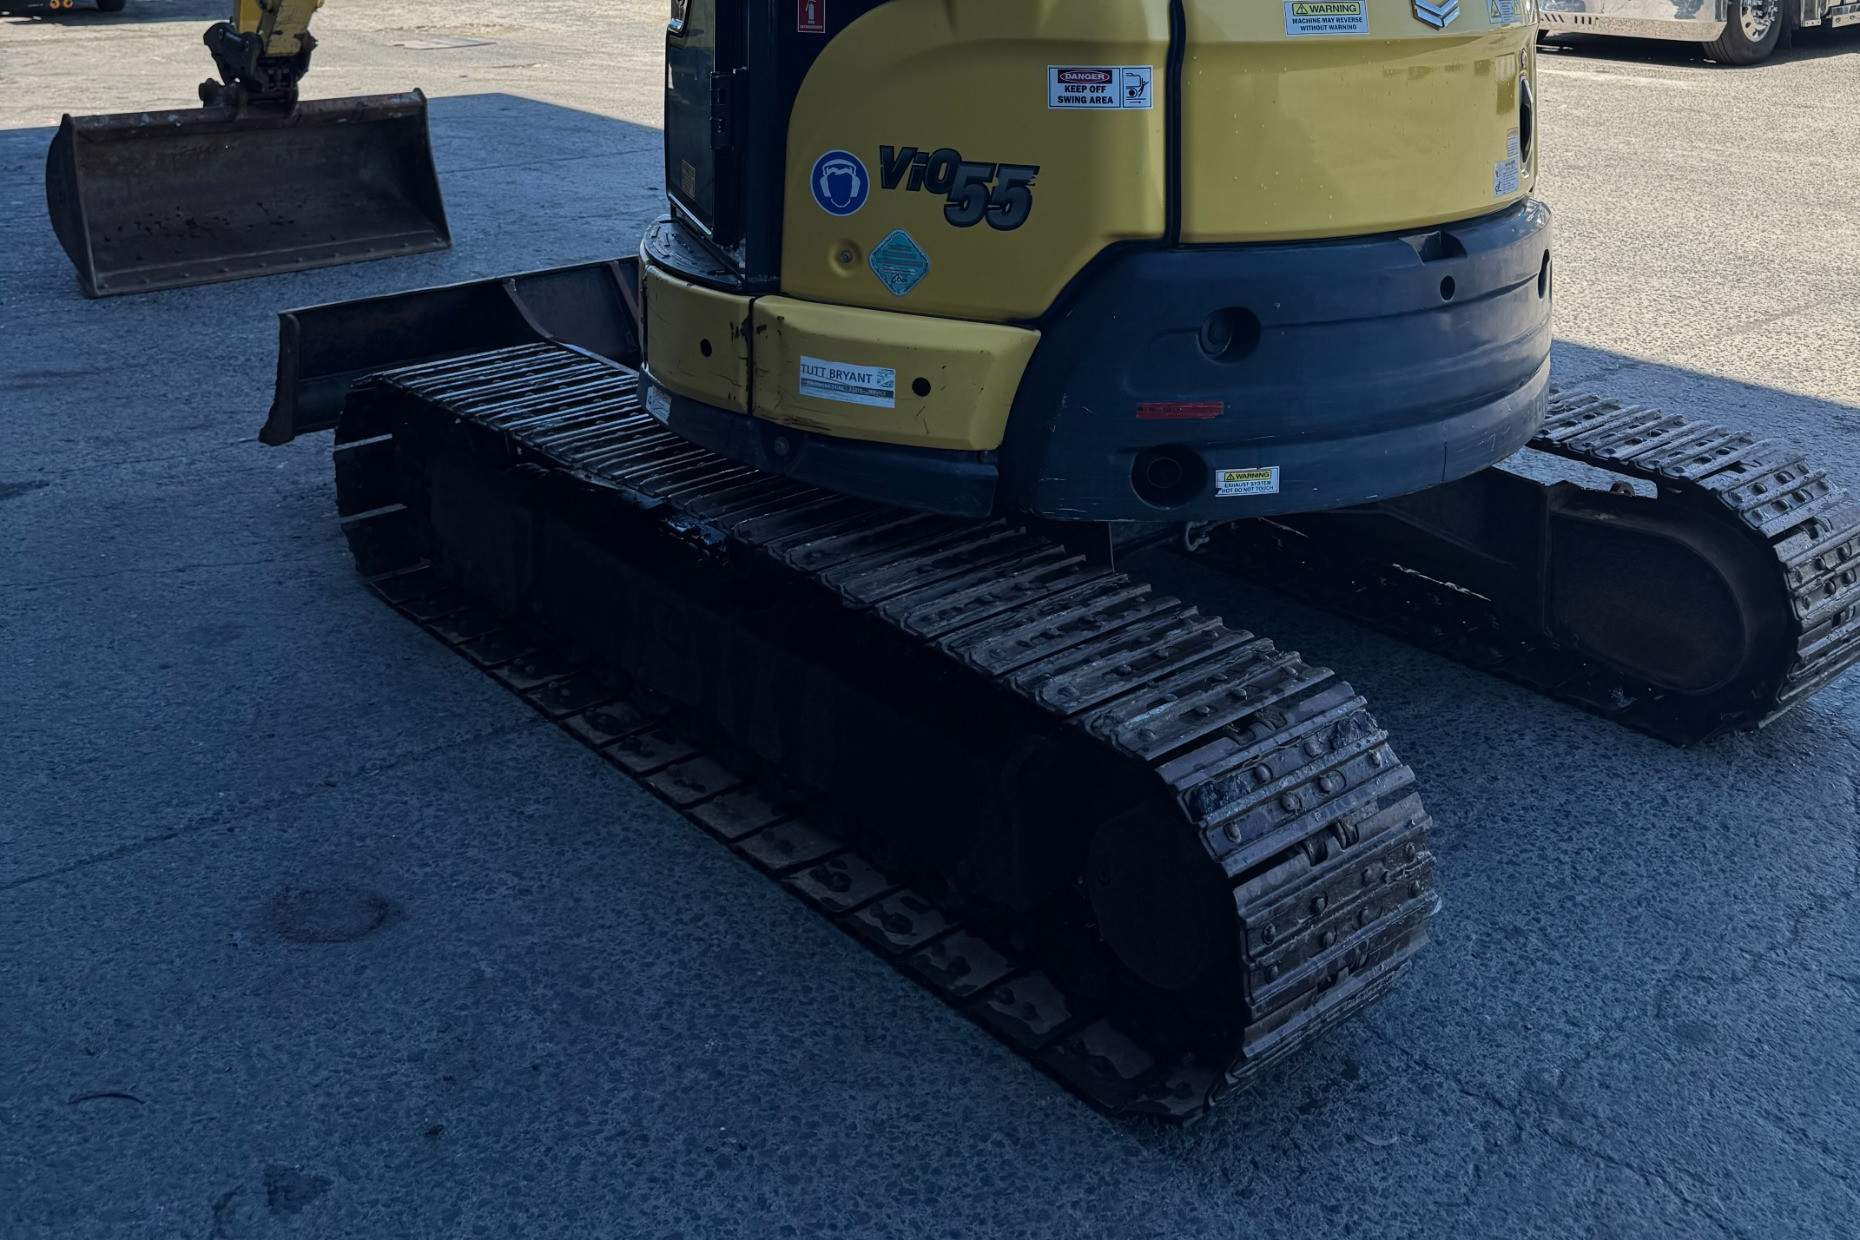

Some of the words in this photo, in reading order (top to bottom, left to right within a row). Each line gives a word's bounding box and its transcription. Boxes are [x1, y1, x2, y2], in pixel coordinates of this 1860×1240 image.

[1309, 4, 1357, 13] WARNING
[1064, 85, 1087, 93] KEEP
[1089, 85, 1107, 93] OFF
[1057, 95, 1087, 104] SWING
[1088, 96, 1114, 104] AREA
[800, 363, 827, 378] TUTT
[829, 368, 873, 384] BRYANT
[1235, 471, 1270, 479] WARNING
